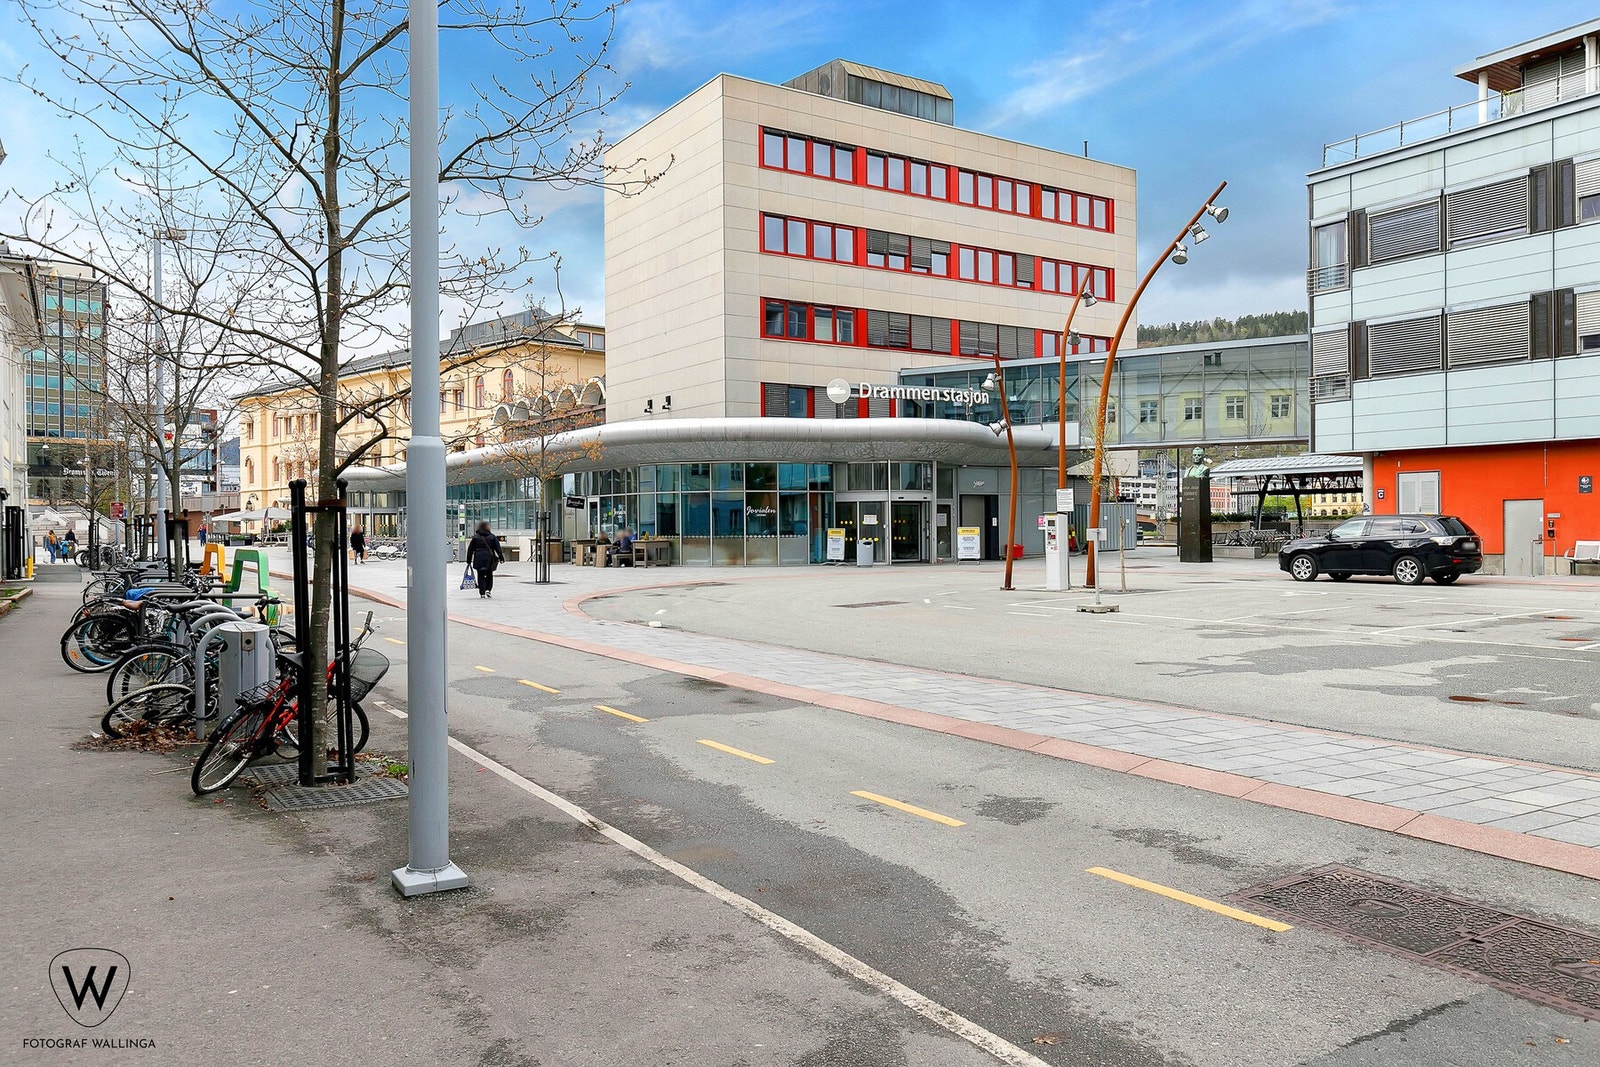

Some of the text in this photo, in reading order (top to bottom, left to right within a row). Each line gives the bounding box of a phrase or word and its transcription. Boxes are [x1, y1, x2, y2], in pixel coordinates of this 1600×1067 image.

[859, 382, 989, 407] Drammen stasjon
[746, 505, 776, 516] Jovialen
